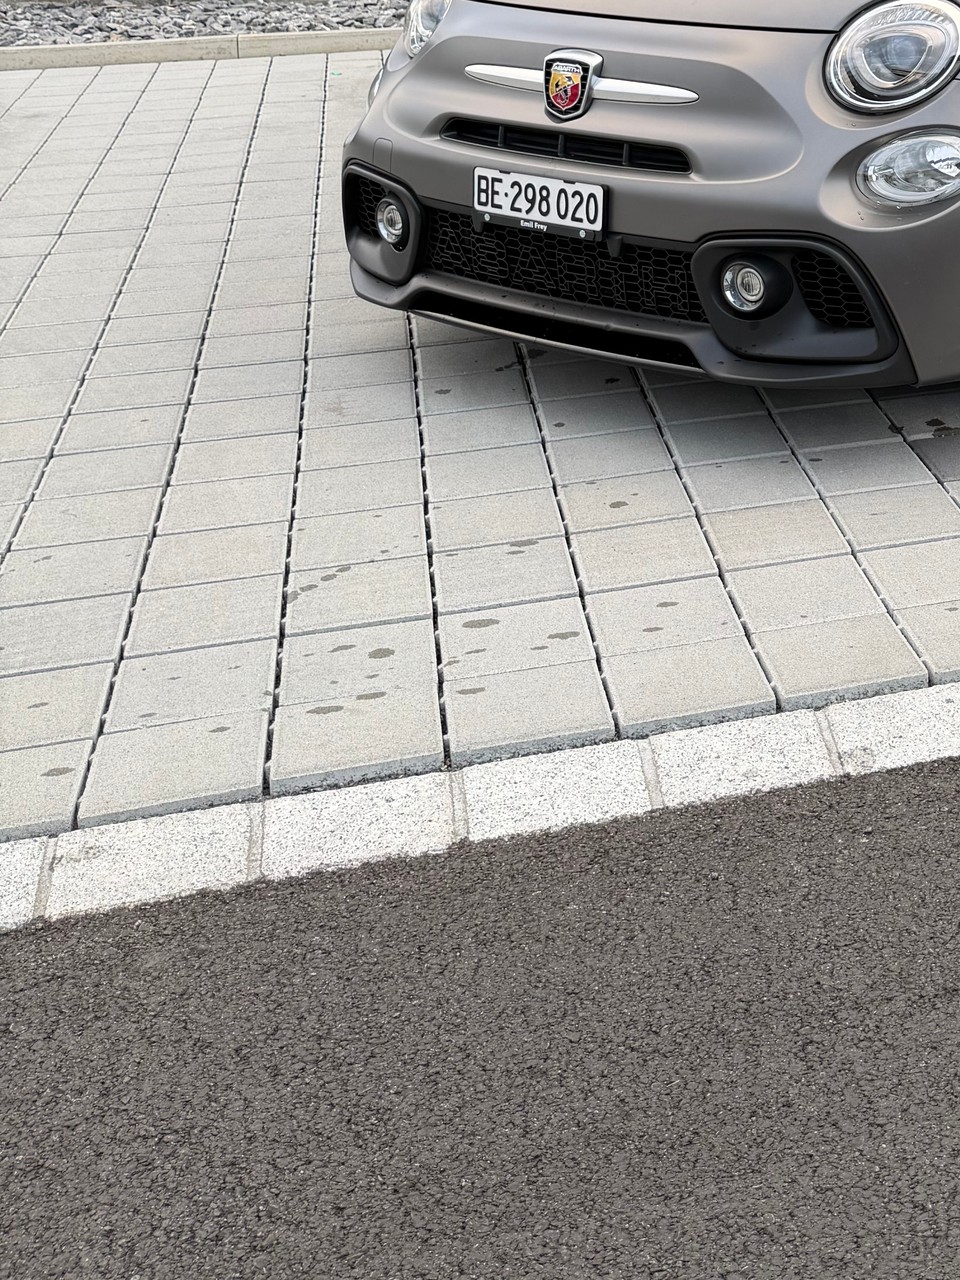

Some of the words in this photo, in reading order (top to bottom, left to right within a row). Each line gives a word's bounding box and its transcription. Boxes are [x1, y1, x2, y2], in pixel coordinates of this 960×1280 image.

[552, 65, 580, 73] ABARTH
[556, 188, 599, 225] 020
[520, 220, 534, 229] Emil
[534, 222, 548, 232] Frey
[433, 228, 689, 312] ABARTH
